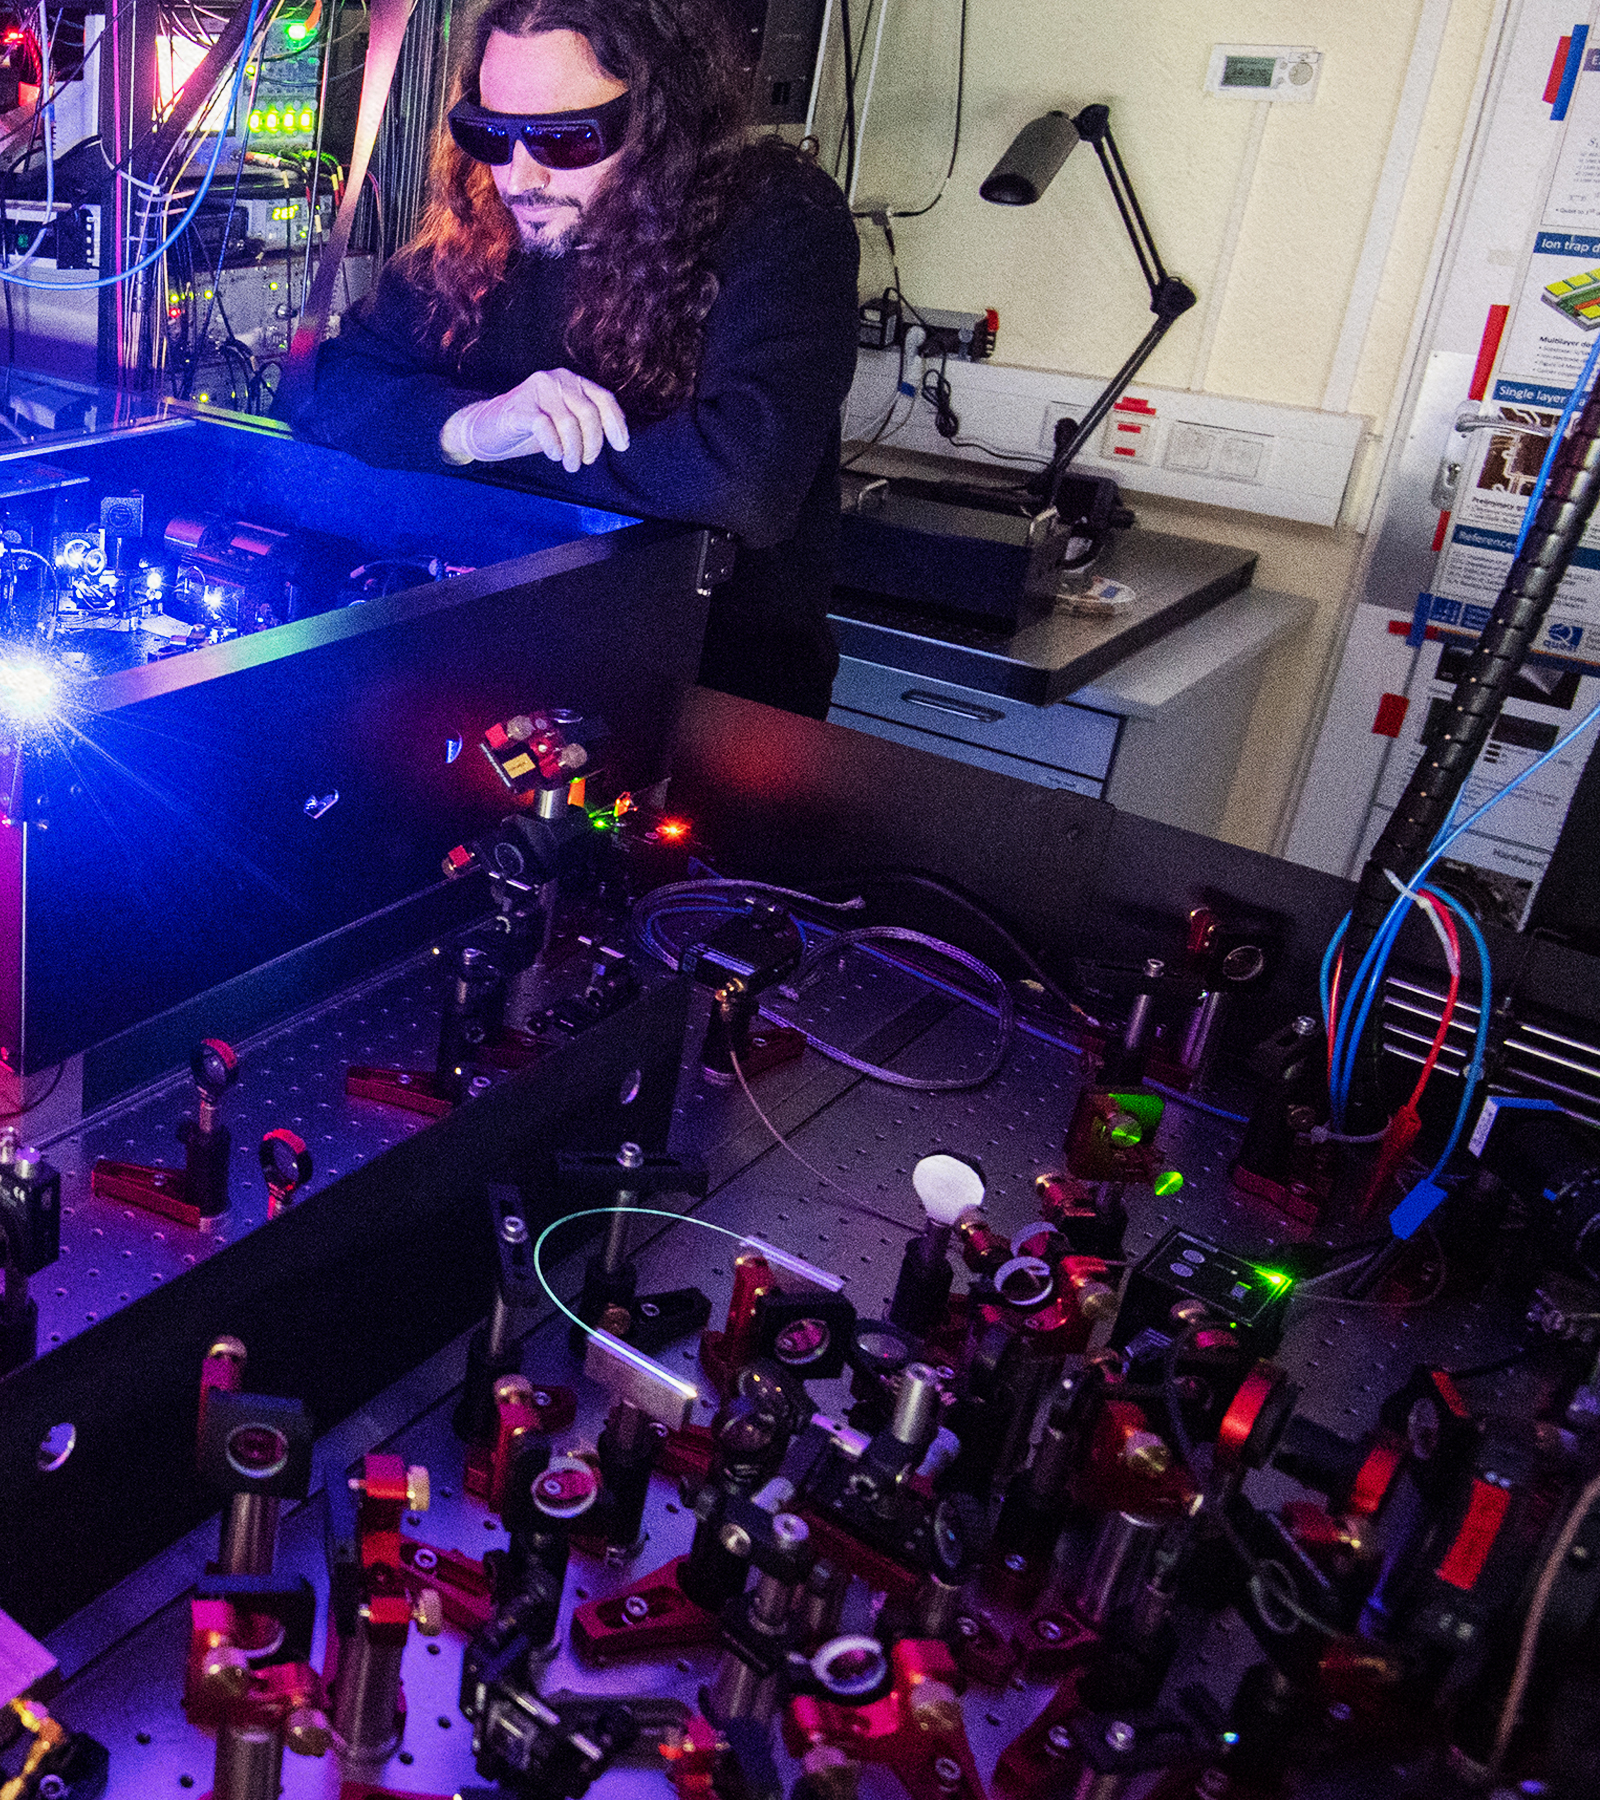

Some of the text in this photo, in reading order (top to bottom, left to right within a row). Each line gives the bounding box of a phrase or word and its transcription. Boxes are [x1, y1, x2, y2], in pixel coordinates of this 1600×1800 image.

[1541, 238, 1561, 250] Ion
[1564, 240, 1590, 253] trap
[1540, 336, 1579, 346] Multilayer
[1499, 385, 1535, 400] Single
[1536, 390, 1567, 403] layer
